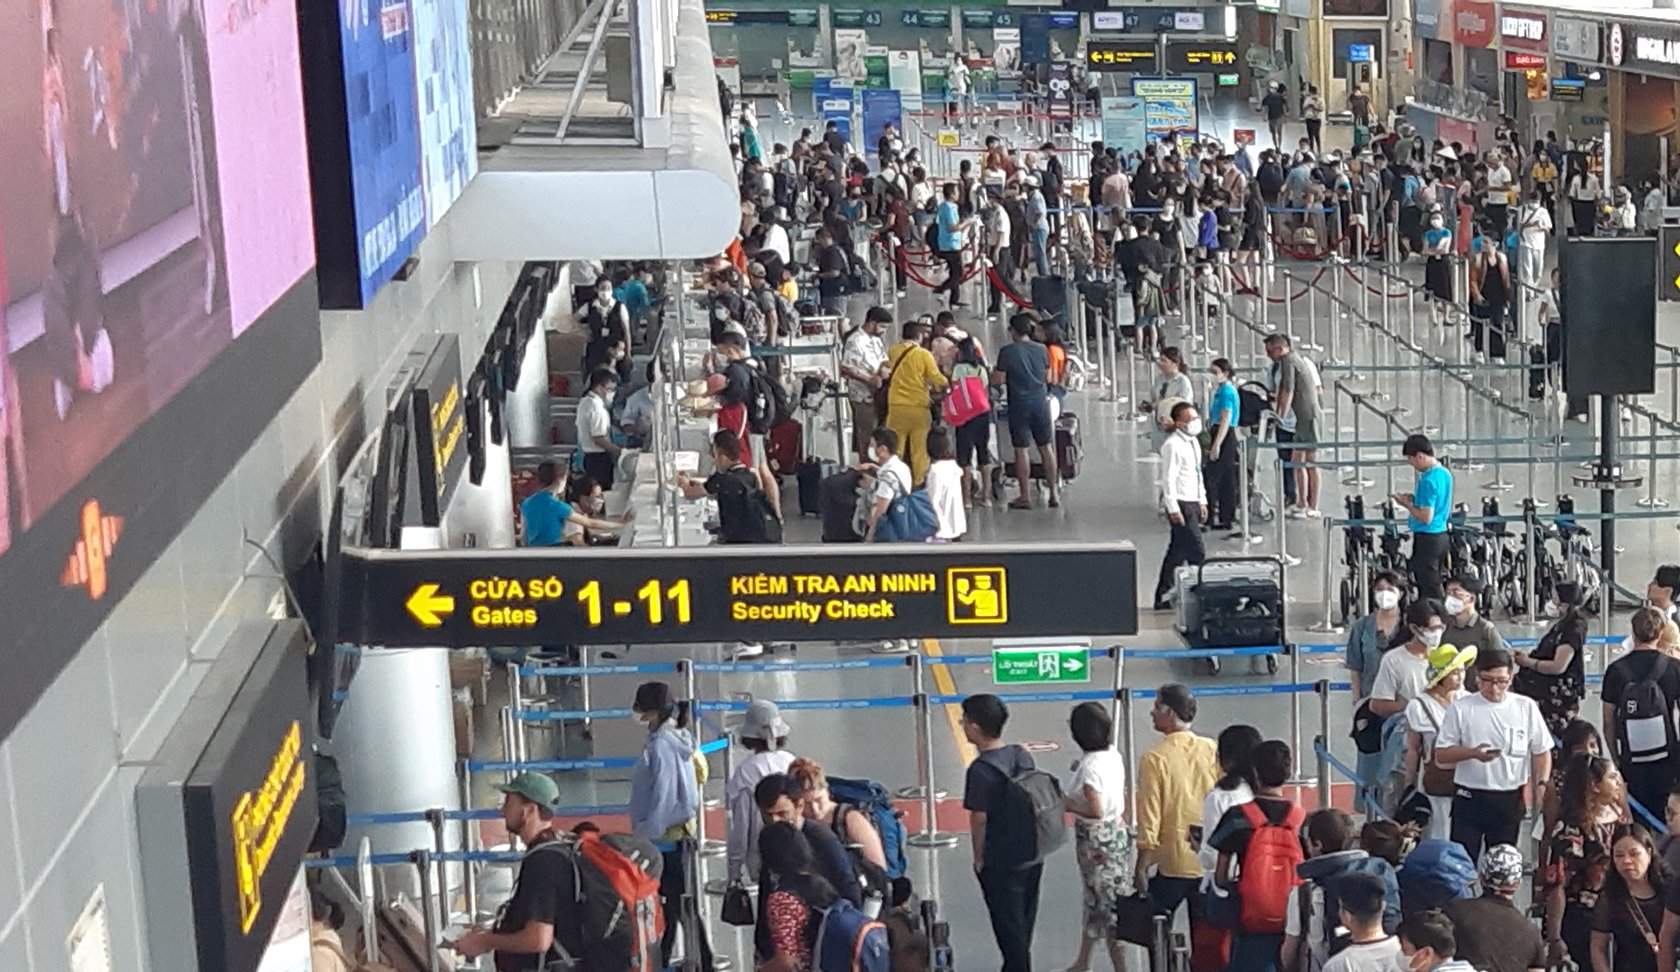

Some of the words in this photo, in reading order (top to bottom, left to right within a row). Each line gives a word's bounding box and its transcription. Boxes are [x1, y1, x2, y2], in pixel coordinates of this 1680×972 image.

[866, 13, 881, 25] 43
[903, 14, 918, 25] 44
[470, 576, 525, 599] CỬA
[731, 572, 788, 595] KIỂM
[793, 575, 840, 594] TRA
[843, 574, 876, 593] AN
[881, 573, 936, 593] NINH
[578, 580, 601, 625] 1
[638, 579, 690, 624] 11
[732, 600, 822, 623] Security
[826, 599, 895, 618] Check
[472, 606, 537, 625] Gates
